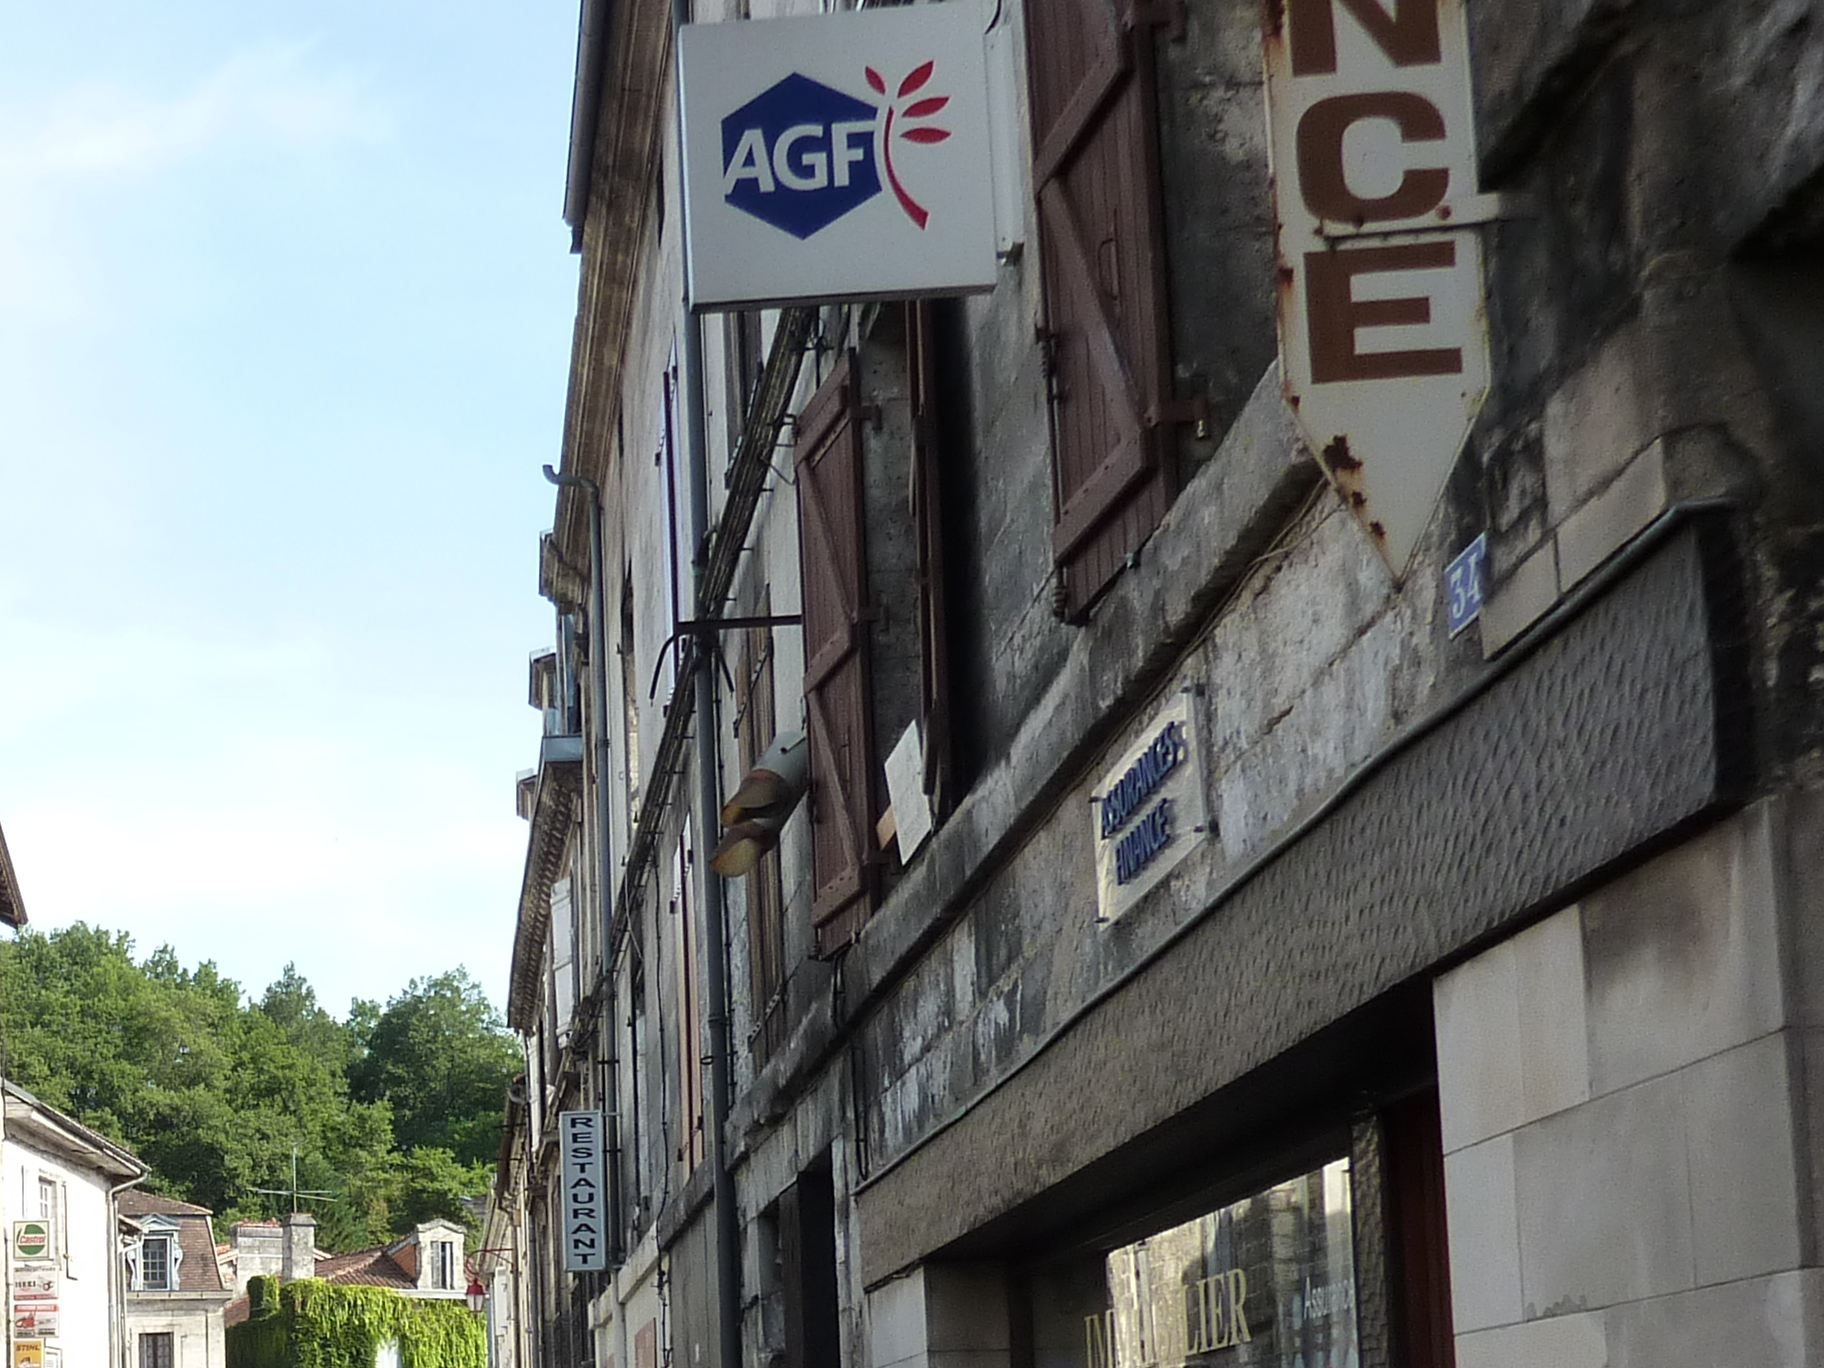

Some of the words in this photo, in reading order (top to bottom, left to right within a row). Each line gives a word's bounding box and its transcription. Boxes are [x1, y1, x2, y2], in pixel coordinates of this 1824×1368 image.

[724, 119, 877, 194] AGF
[1450, 551, 1484, 619] 34
[570, 1117, 597, 1265] RESTAURANT
[16, 1344, 41, 1352] STIHL
